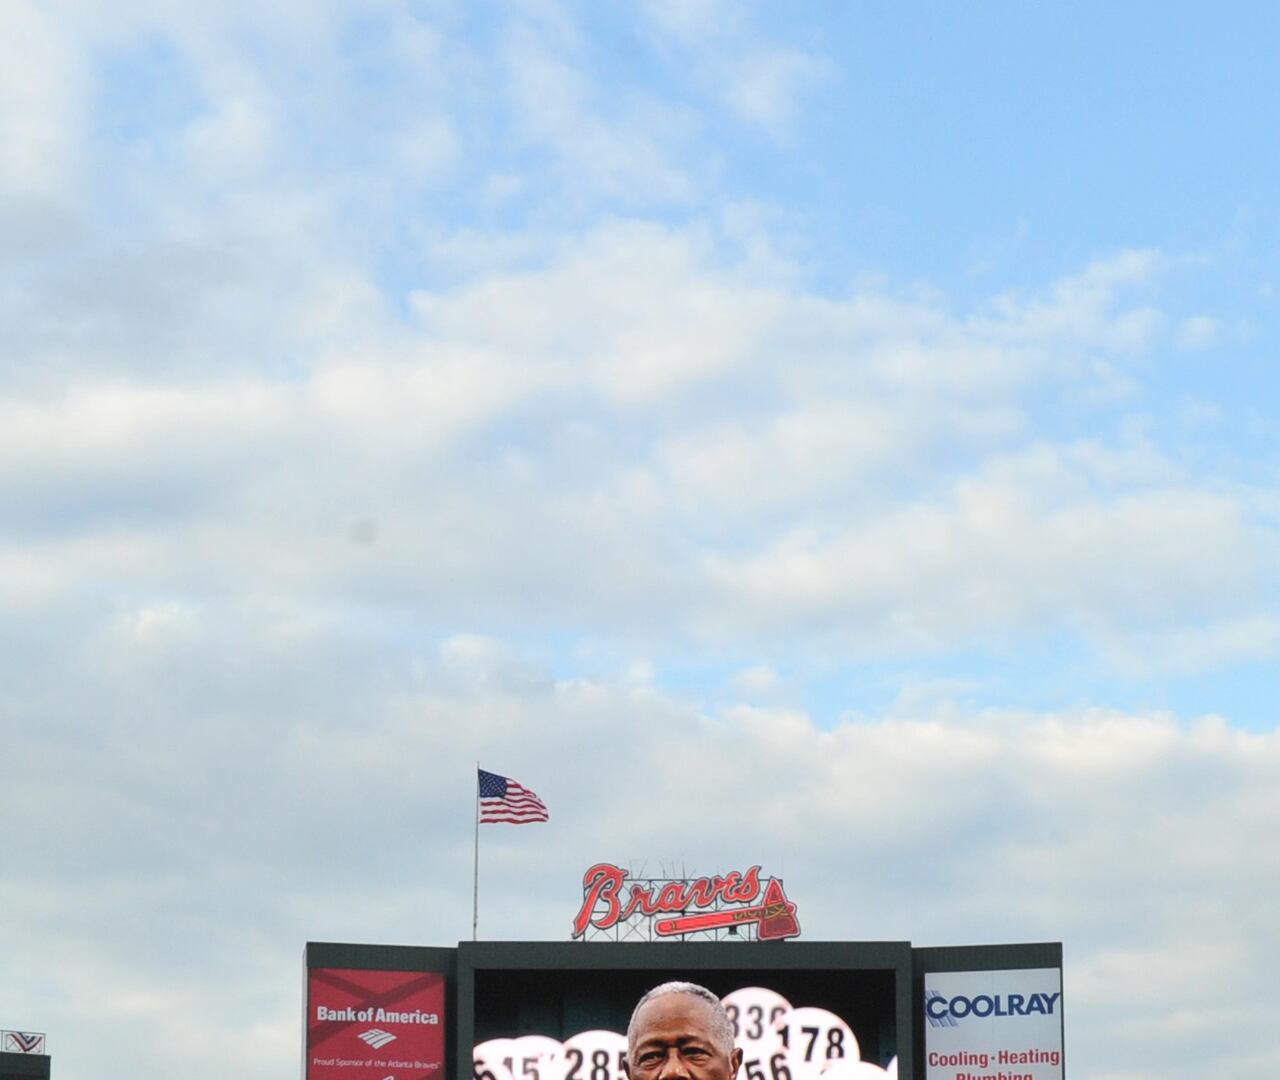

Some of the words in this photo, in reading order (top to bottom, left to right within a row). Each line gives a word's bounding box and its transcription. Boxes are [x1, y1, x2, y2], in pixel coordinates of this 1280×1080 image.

[571, 862, 762, 940] Braves
[317, 1006, 357, 1022] Bank
[357, 1007, 373, 1022] of
[375, 1008, 439, 1024] America
[926, 992, 1060, 1019] COOLRAY
[313, 1058, 335, 1066] Proud
[336, 1058, 363, 1067] Sponsor
[365, 1059, 372, 1067] of
[374, 1059, 386, 1067] the
[388, 1059, 413, 1068] Atlanta
